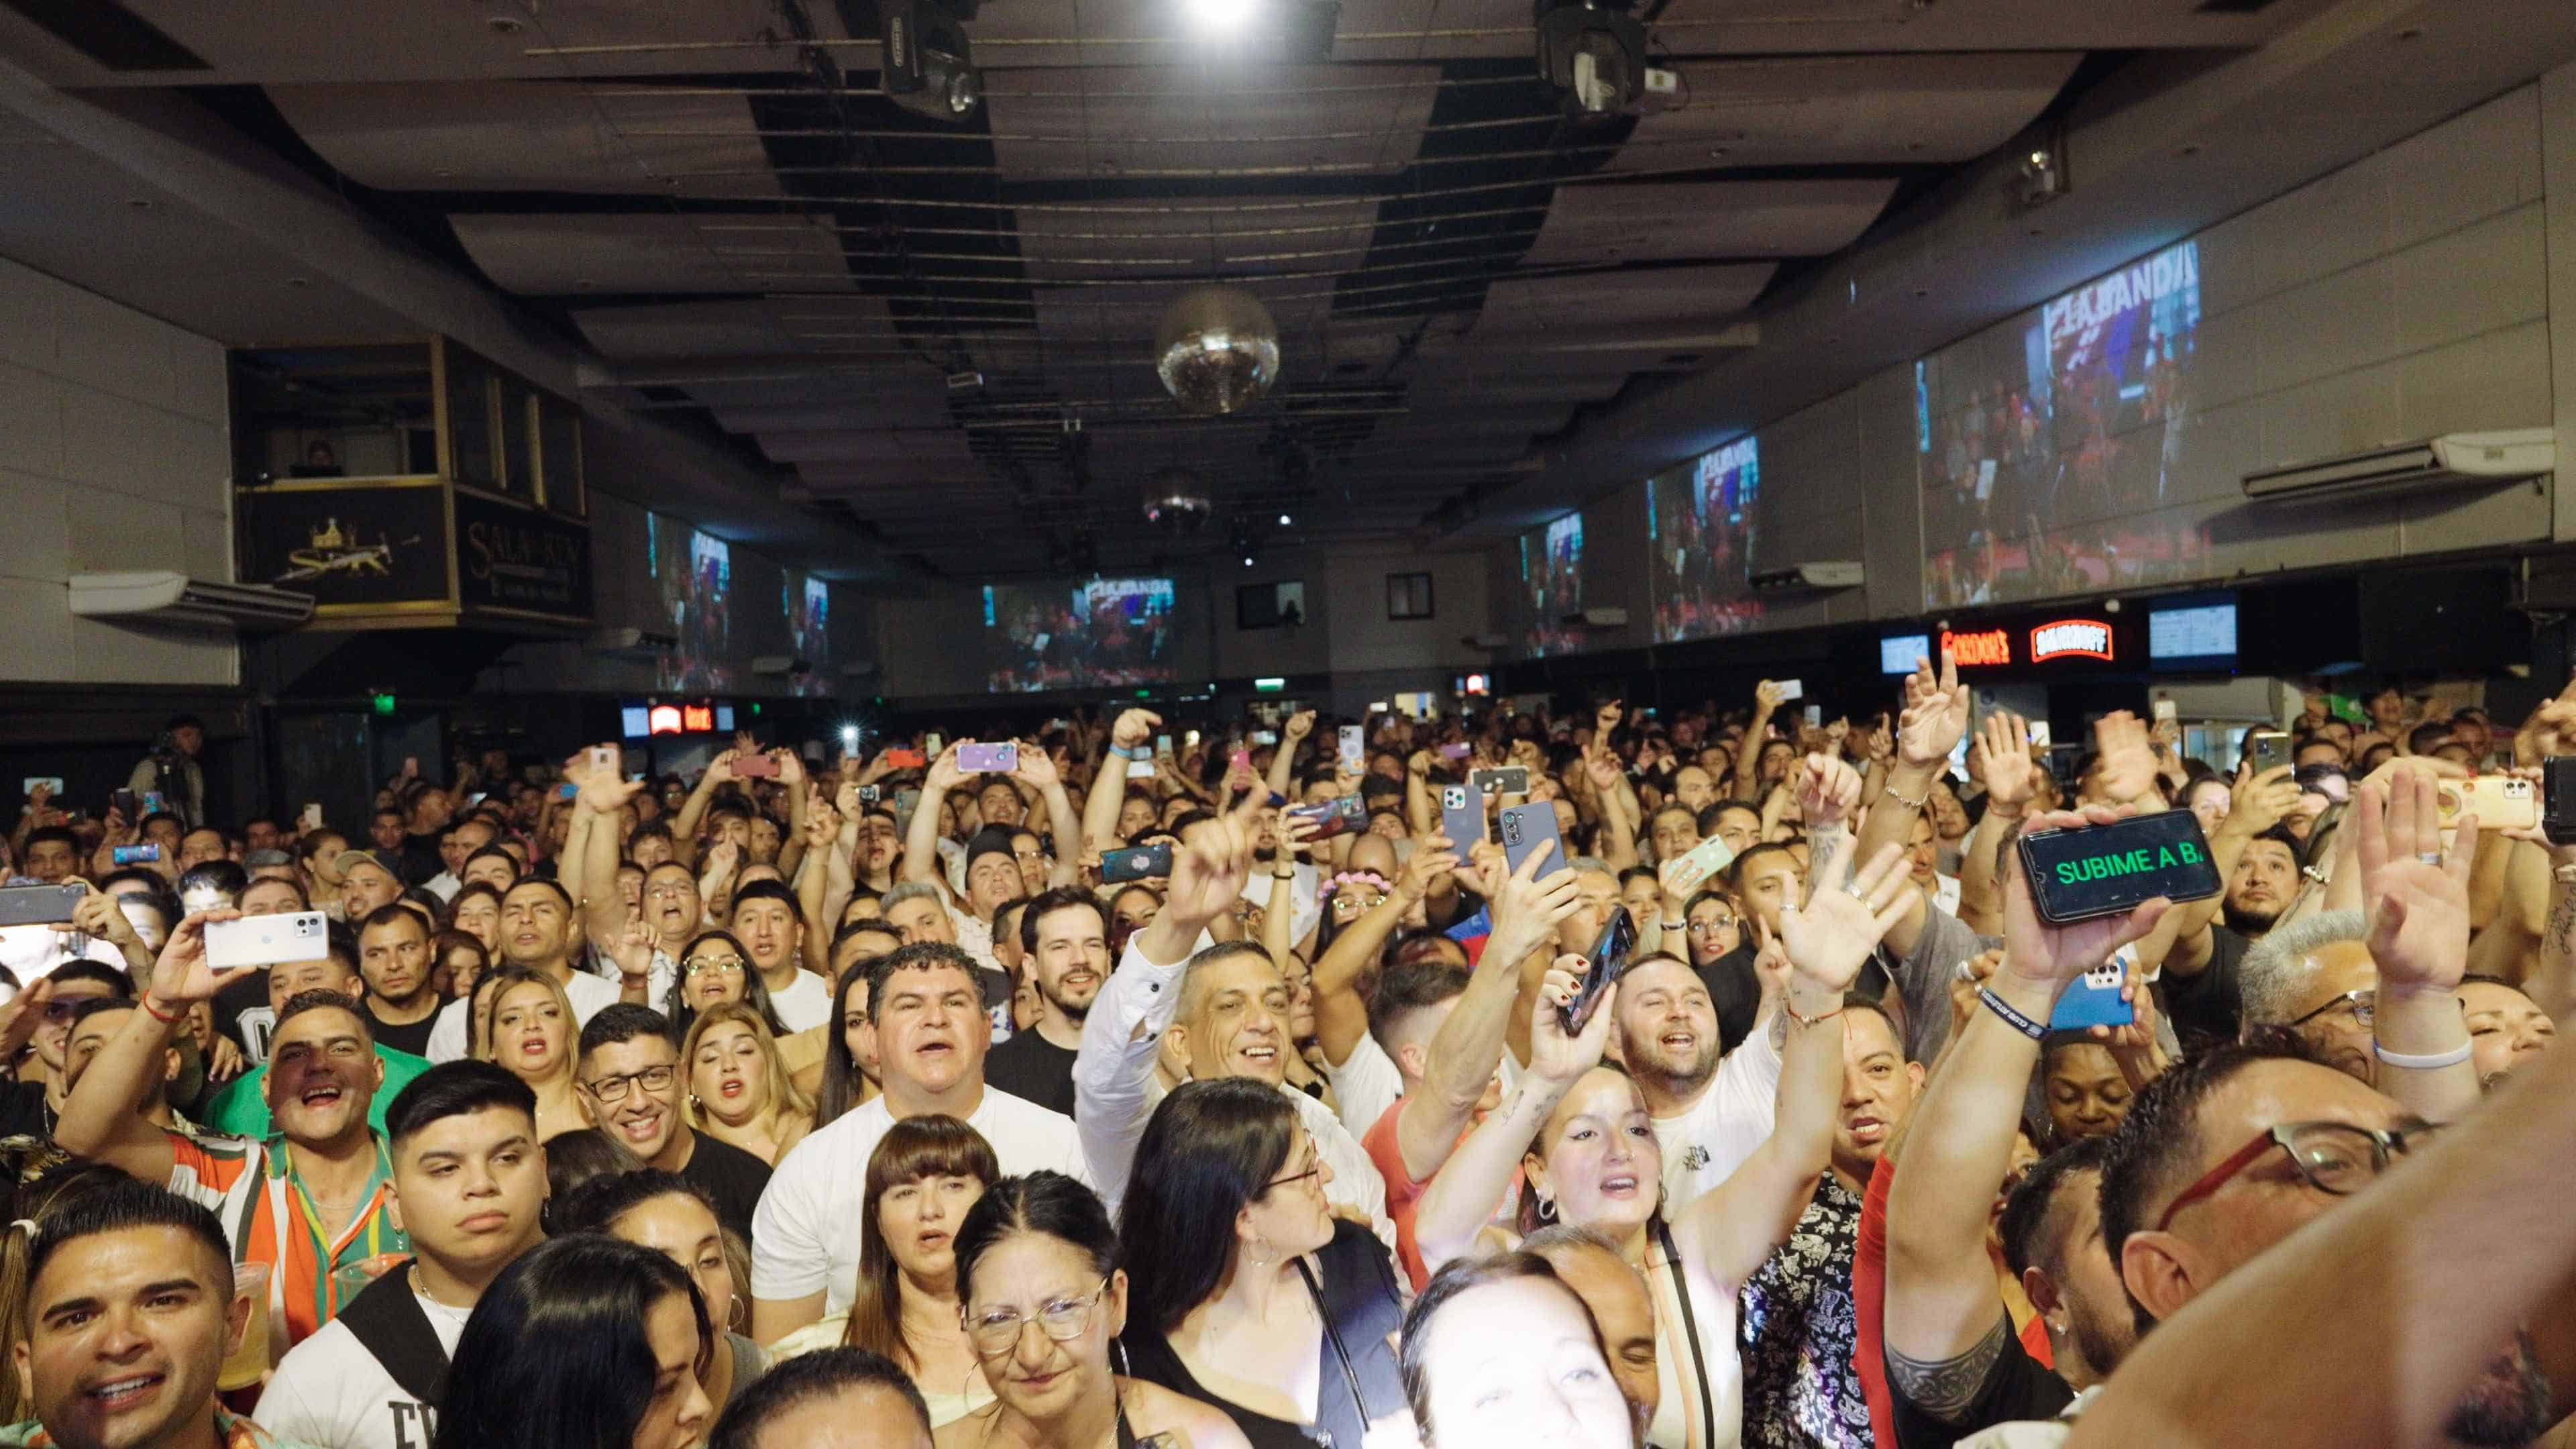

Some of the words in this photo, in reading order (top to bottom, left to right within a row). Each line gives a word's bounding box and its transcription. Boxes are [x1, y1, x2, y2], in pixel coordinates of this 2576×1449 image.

[2056, 849, 2155, 885] SUBIME
[2159, 846, 2178, 868] A
[2178, 841, 2204, 865] B
